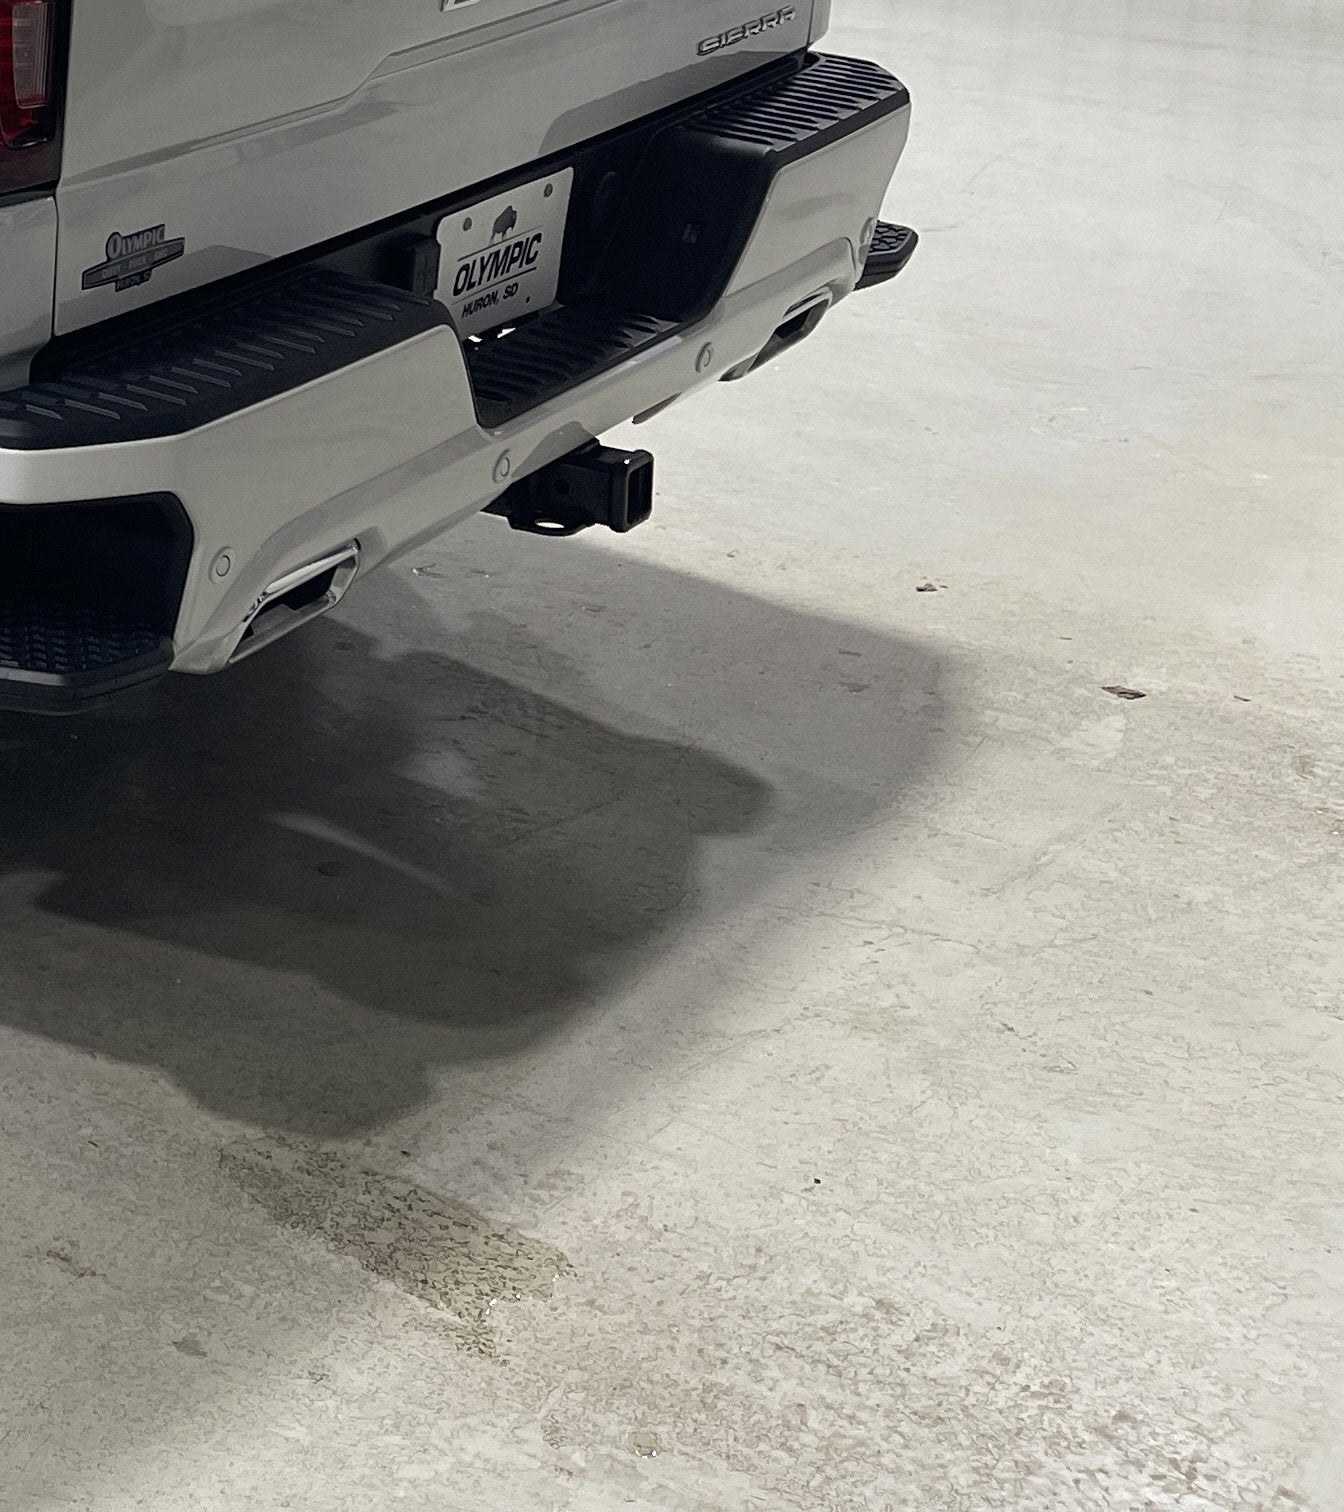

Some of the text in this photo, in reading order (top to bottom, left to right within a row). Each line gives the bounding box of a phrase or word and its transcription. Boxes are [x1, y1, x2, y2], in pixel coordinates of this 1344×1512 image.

[696, 5, 796, 57] SIERRA
[452, 231, 543, 298] OLYMPIC
[461, 282, 519, 320] HURON, SD
